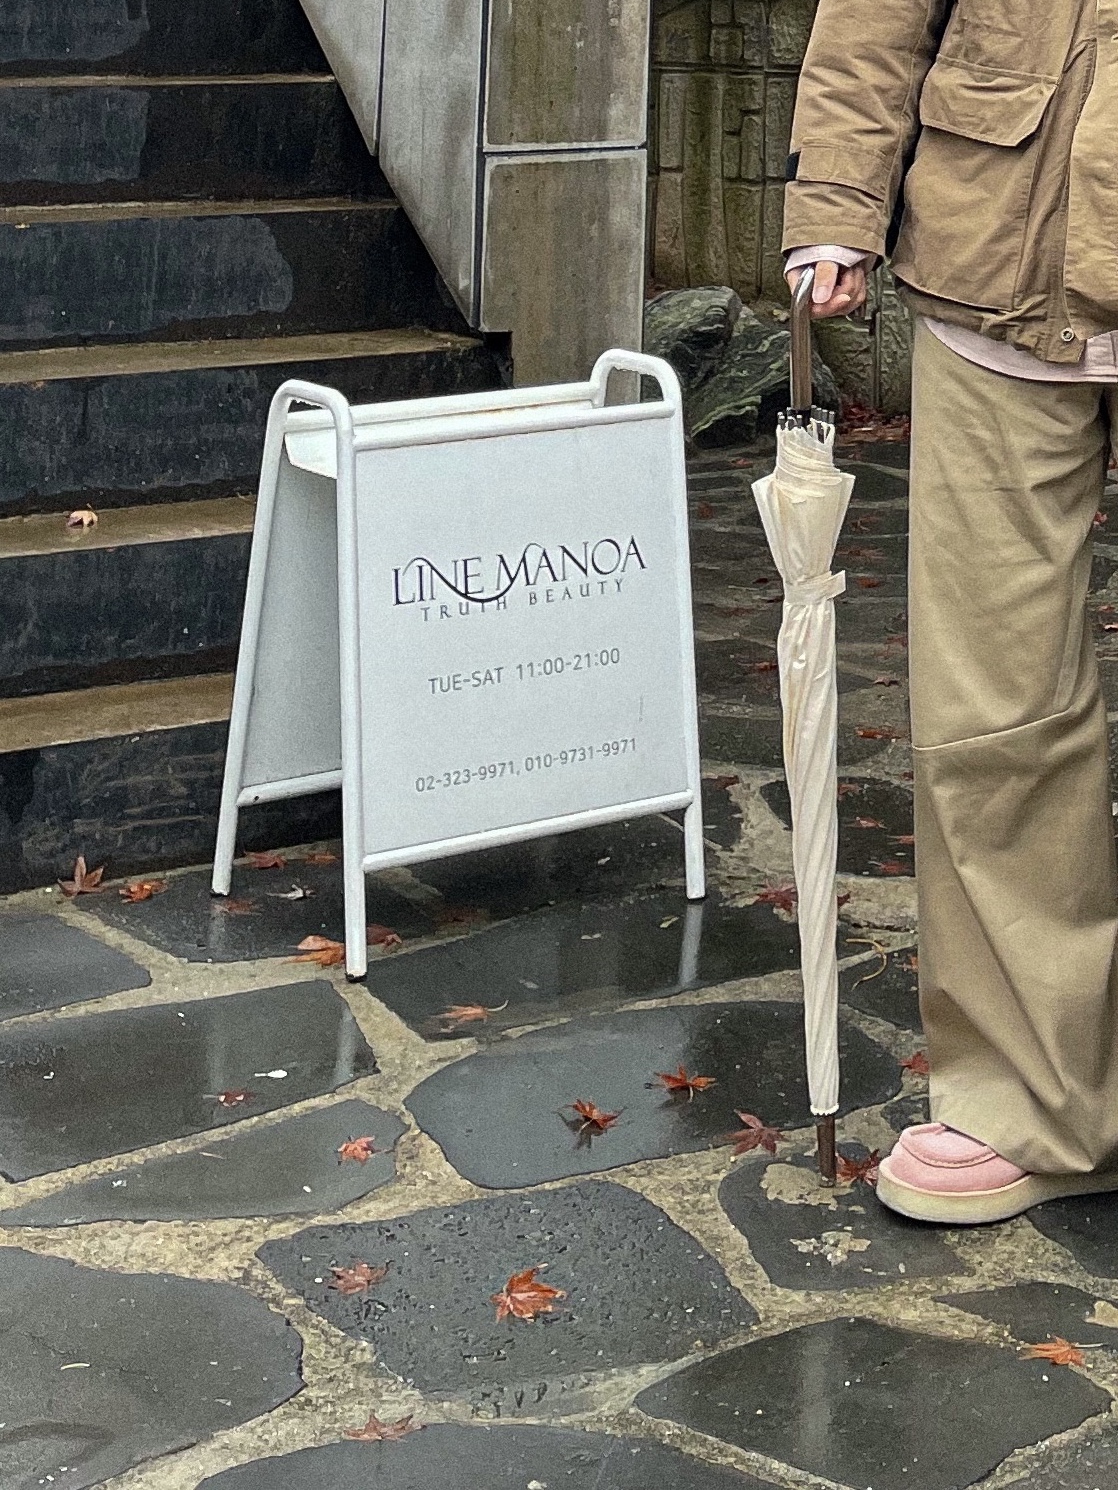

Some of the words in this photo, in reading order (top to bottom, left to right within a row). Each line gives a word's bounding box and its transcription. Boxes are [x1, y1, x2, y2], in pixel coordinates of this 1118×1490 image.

[392, 557, 484, 606] LINE
[496, 535, 647, 593] MANOA
[420, 596, 508, 621] TRUTH
[529, 578, 623, 606] BEAUTY
[428, 666, 504, 694] TUE-SAT
[516, 647, 620, 680] 11:00-21:00
[415, 760, 520, 793] 02-323-9971,
[525, 738, 636, 772] 010-9731-9971
